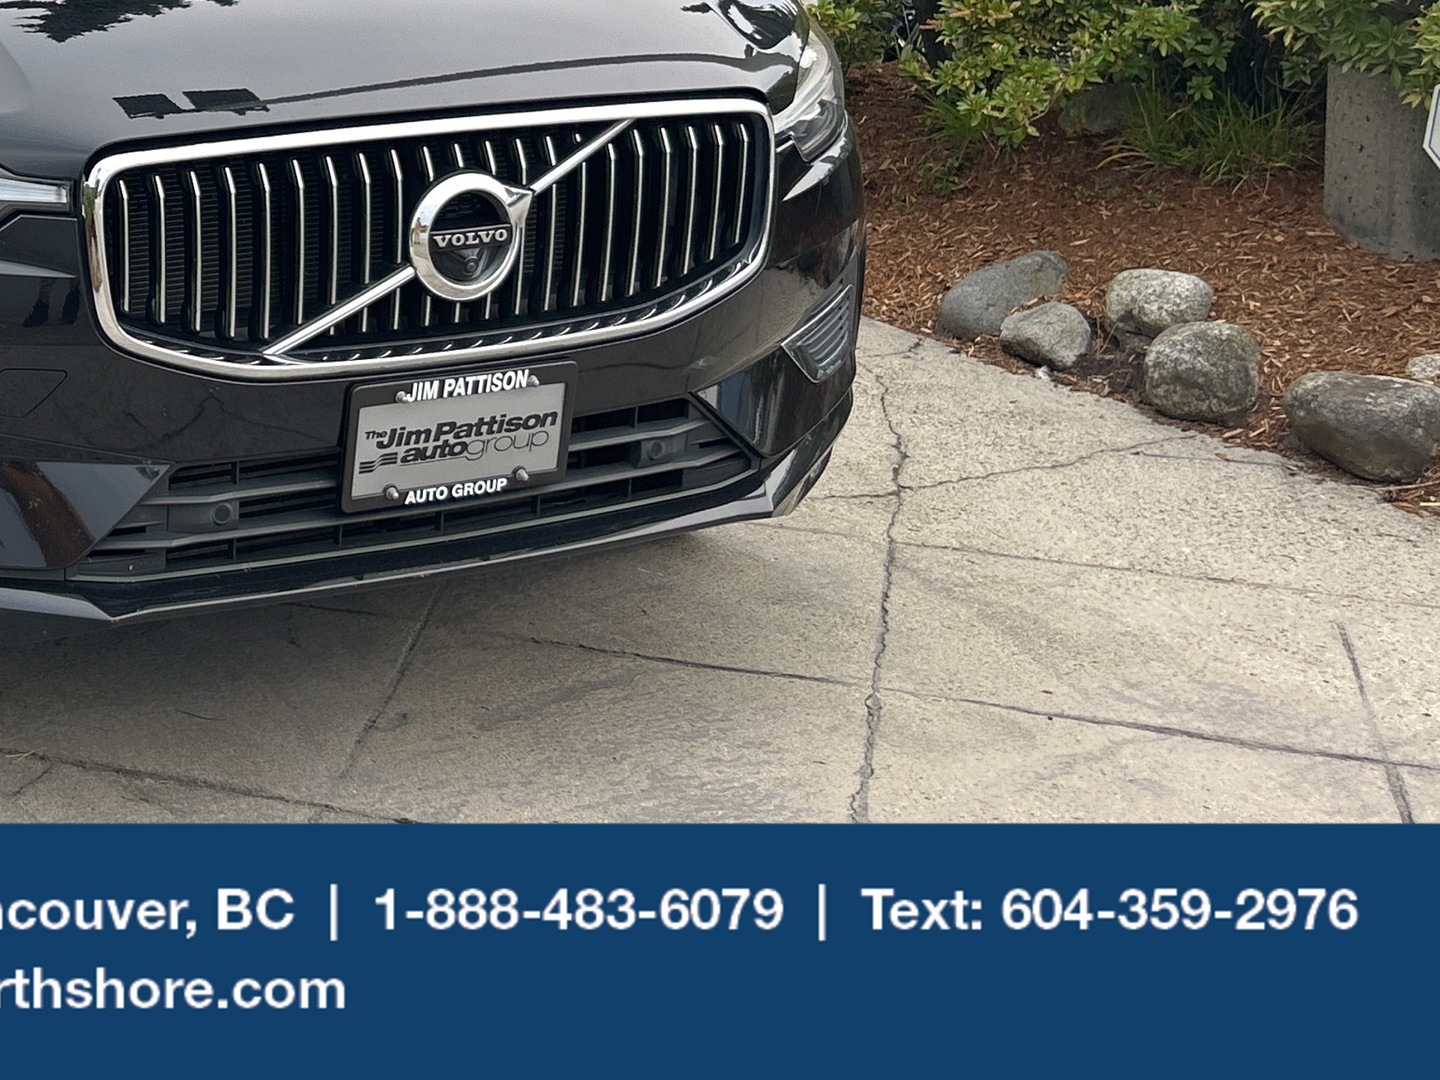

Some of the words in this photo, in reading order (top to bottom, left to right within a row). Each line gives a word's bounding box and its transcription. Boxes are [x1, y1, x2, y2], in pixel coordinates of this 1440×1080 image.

[432, 228, 508, 248] VOLVO
[406, 380, 440, 402] JIM
[442, 369, 530, 398] PATTISON
[365, 430, 388, 441] The
[404, 486, 448, 506] AUTO
[451, 477, 508, 499] GROUP
